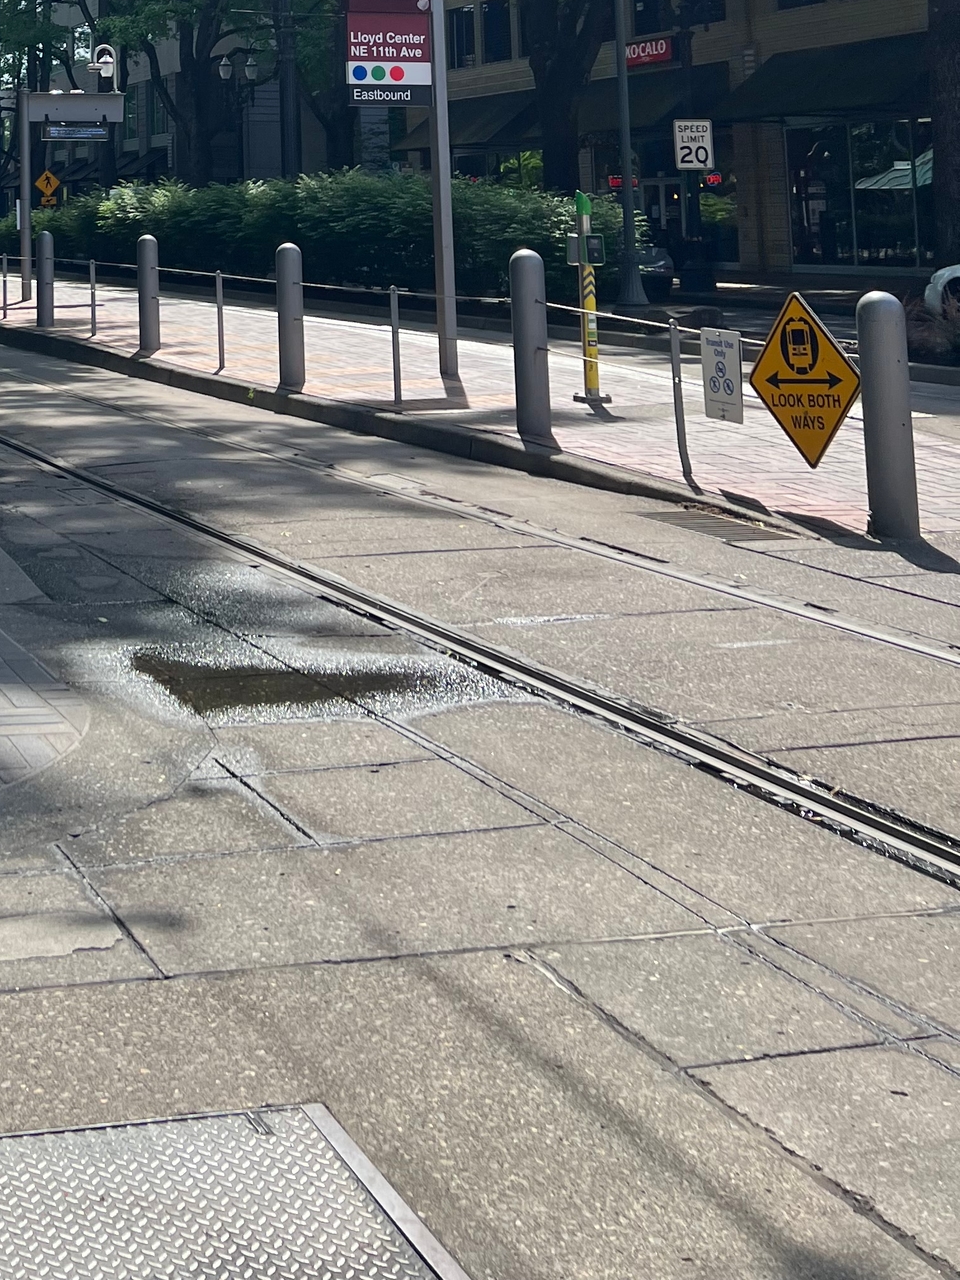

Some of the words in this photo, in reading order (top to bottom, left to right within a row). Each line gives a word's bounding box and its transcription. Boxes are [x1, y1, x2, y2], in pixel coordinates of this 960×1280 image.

[350, 32, 383, 45] Lloyd
[386, 32, 425, 44] Center
[350, 46, 368, 56] NE
[371, 46, 397, 57] 11th
[400, 46, 422, 57] Ave
[353, 88, 411, 100] Eastbound
[677, 124, 708, 133] SPEED
[681, 135, 705, 143] LIMIT
[679, 145, 709, 164] 20
[724, 339, 734, 349] Use
[713, 348, 726, 360] Only
[771, 393, 805, 408] LOOK
[807, 393, 842, 409] BOTH
[791, 414, 825, 431] WAYS
